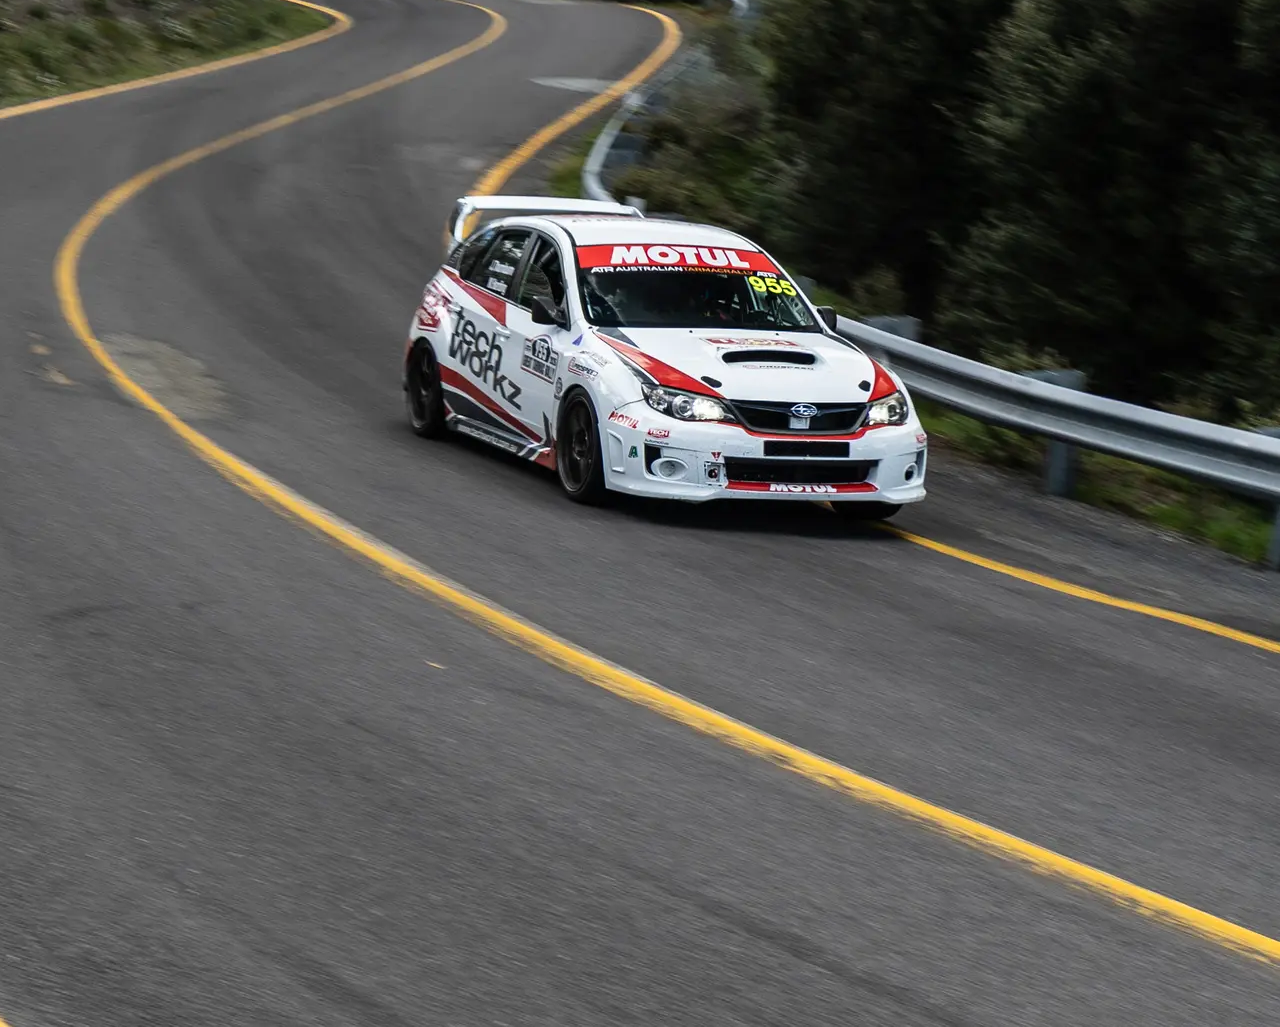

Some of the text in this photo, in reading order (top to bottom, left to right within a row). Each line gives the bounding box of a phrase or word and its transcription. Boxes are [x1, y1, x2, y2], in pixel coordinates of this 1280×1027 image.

[611, 245, 750, 268] MOTUL
[591, 266, 614, 274] ATR
[748, 275, 797, 296] 955
[454, 305, 503, 363] tech
[448, 332, 522, 411] workz
[608, 410, 639, 429] MOTUL
[769, 483, 838, 493] MOTUL
